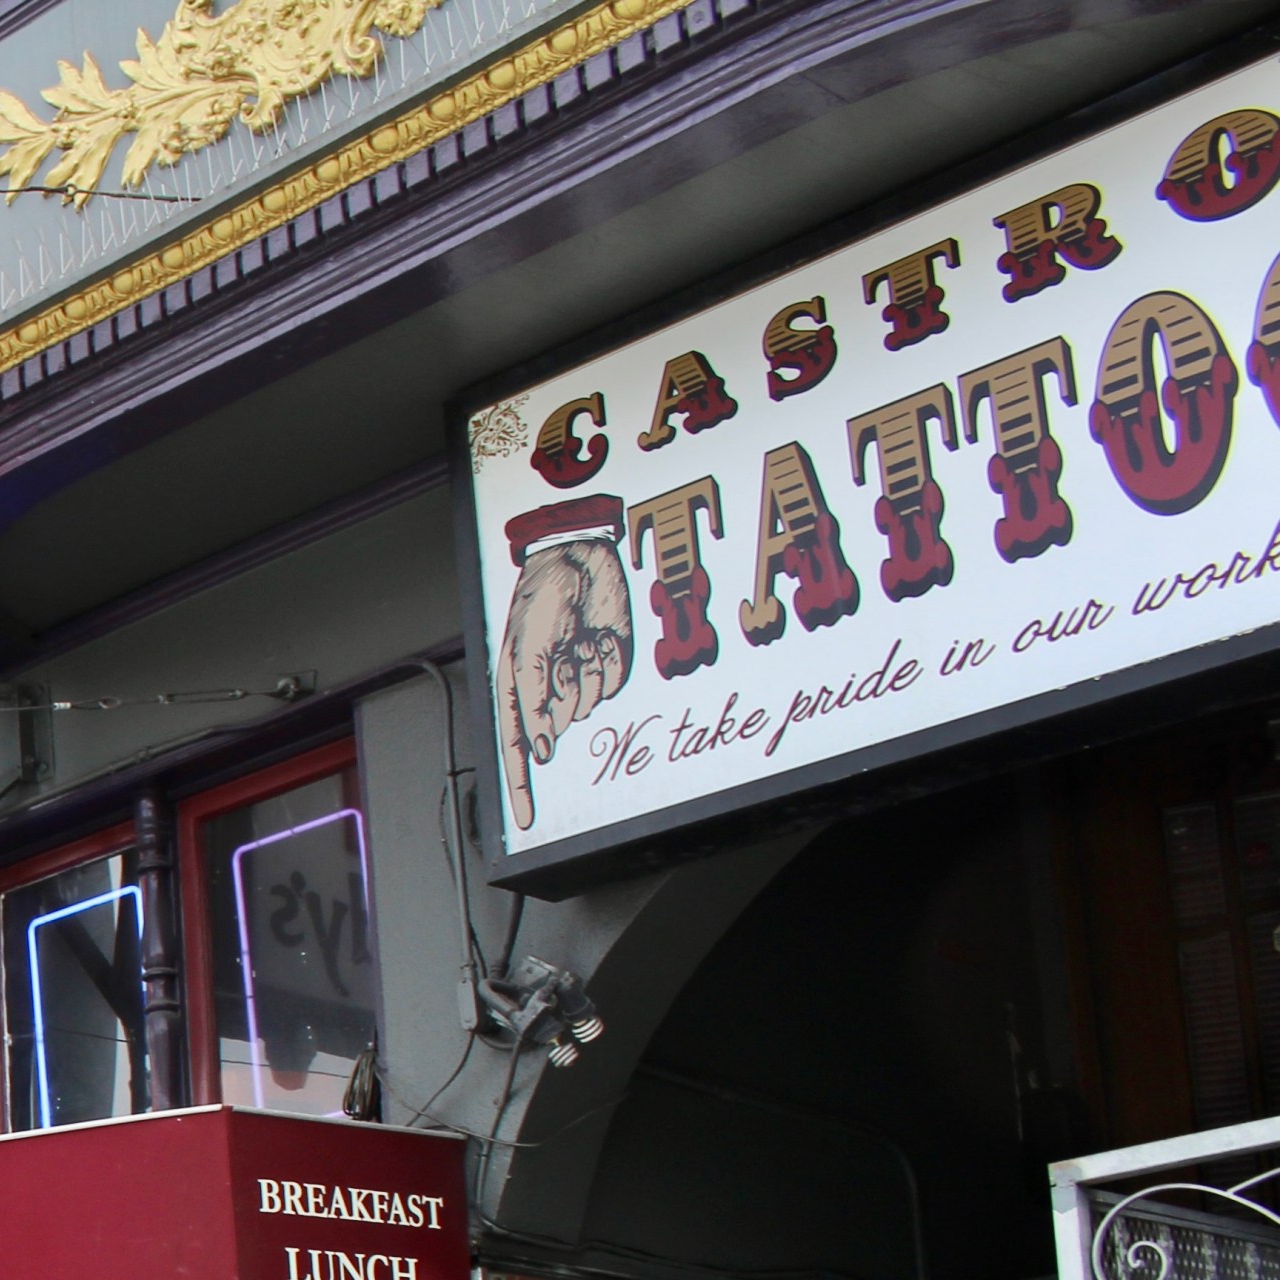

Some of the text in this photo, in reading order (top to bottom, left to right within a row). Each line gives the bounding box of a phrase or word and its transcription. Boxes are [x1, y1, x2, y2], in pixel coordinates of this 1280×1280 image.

[529, 107, 1280, 490] CASTRO
[627, 249, 1280, 681] TATTO
[591, 726, 652, 786] We
[667, 705, 771, 766] take
[768, 640, 923, 757] pride
[941, 636, 997, 676] in
[1012, 598, 1115, 653] our
[257, 1178, 443, 1230] BREAKFAST
